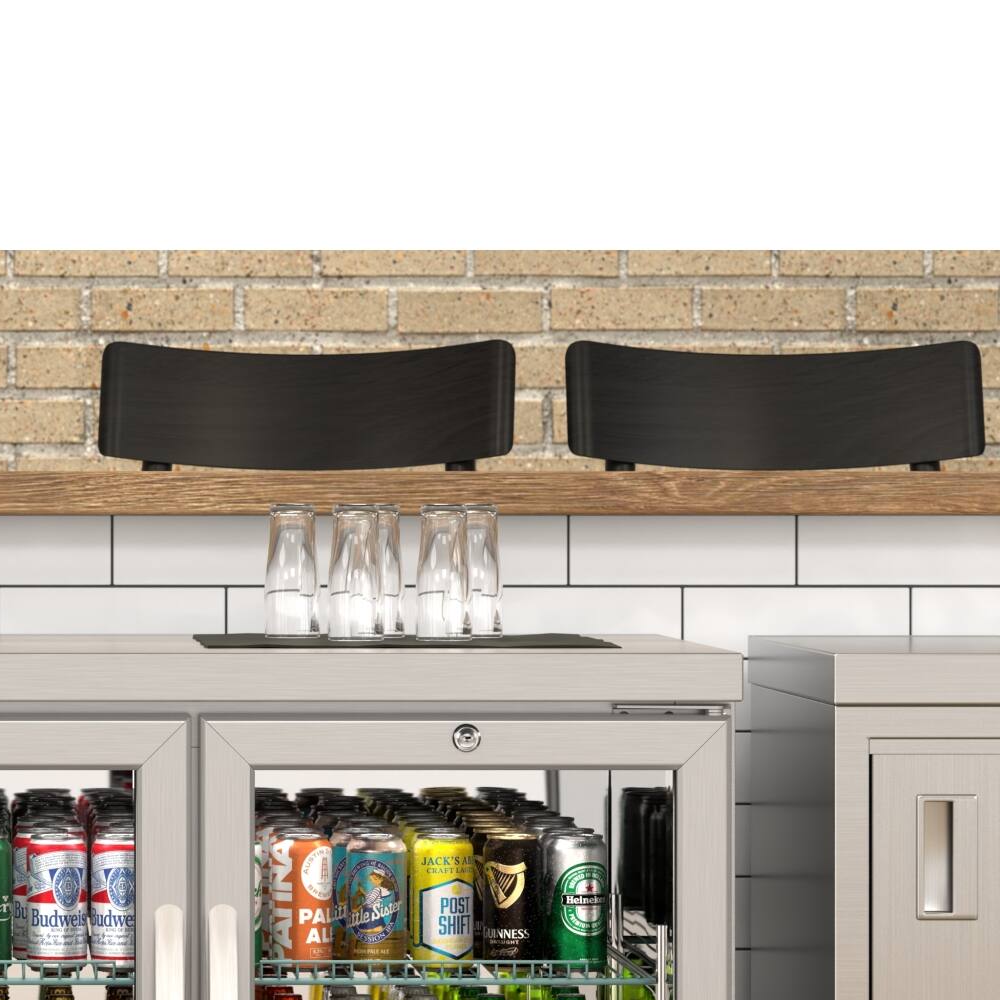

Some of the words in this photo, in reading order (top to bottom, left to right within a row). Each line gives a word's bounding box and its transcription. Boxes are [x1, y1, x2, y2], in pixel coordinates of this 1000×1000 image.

[421, 856, 460, 866] JACK'S
[371, 900, 402, 921] Sister
[440, 897, 470, 914] POST
[31, 908, 86, 928] Budweis
[298, 908, 331, 925] PAL
[438, 914, 471, 935] SHIFT
[305, 927, 332, 944] AL
